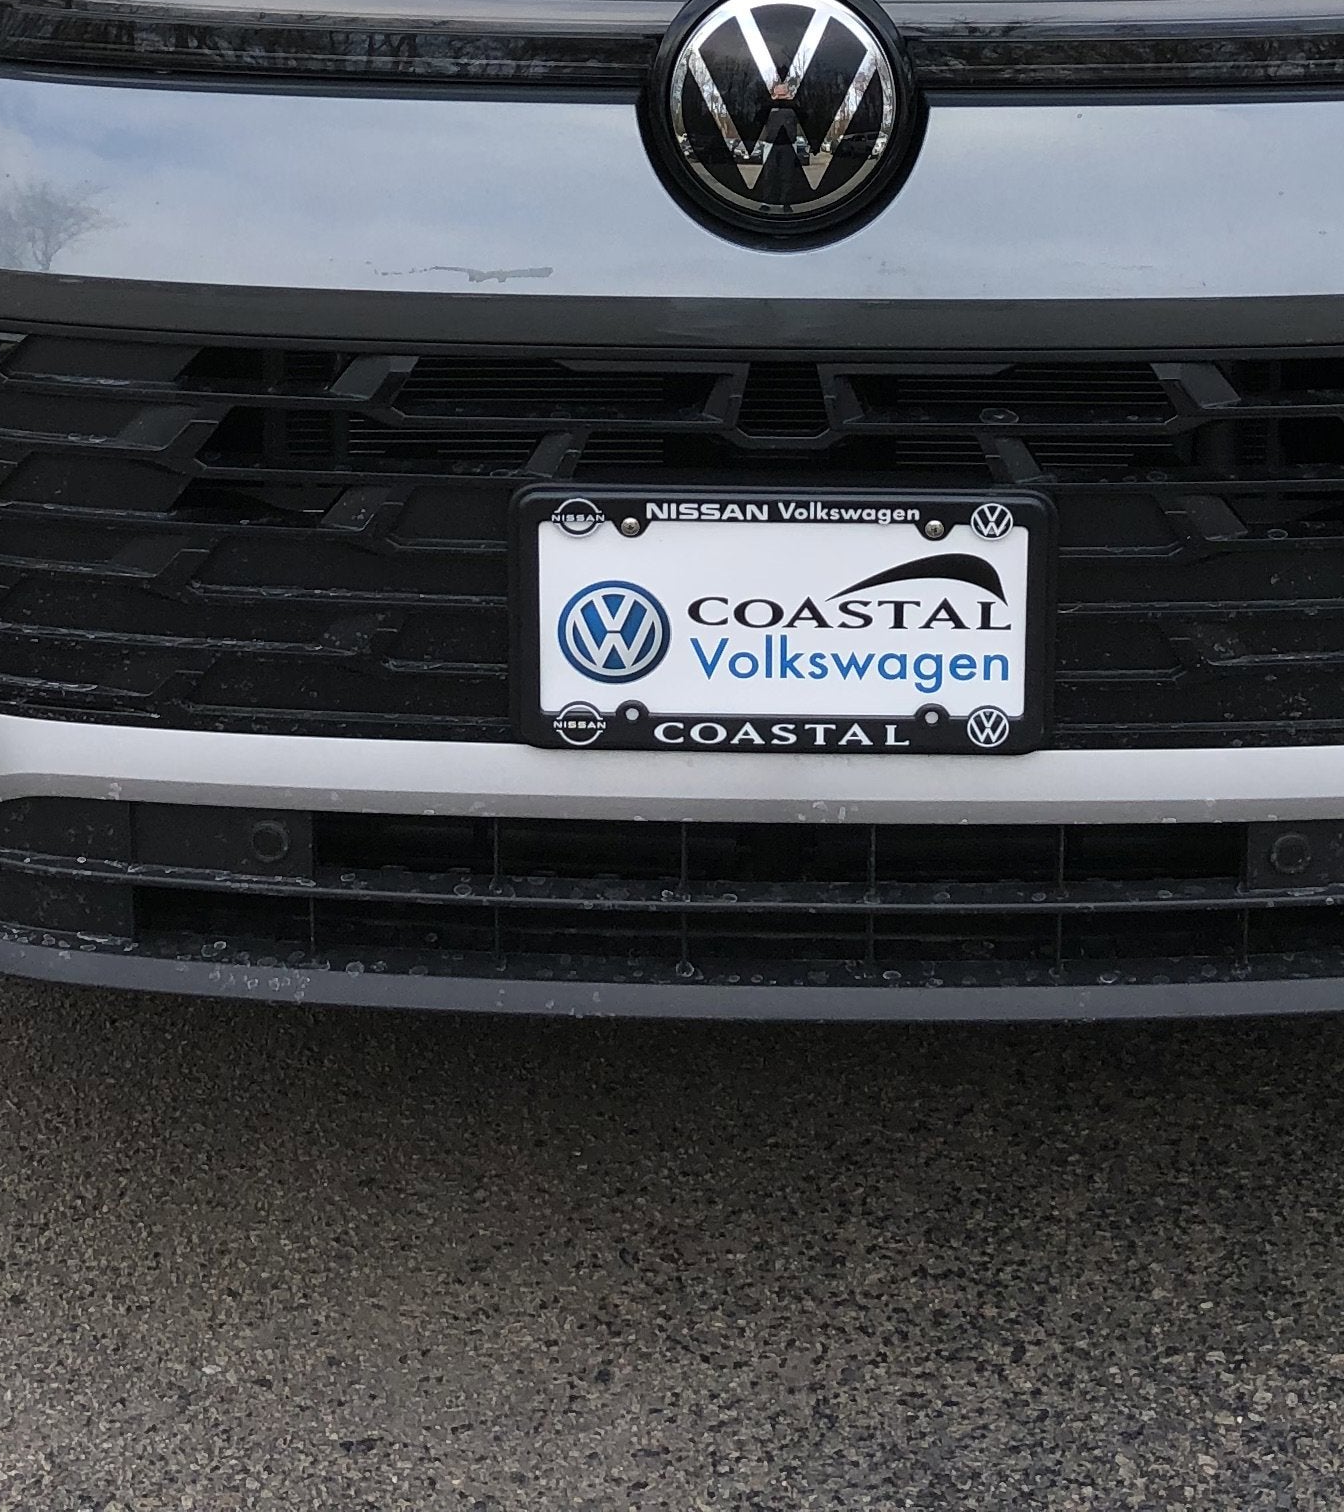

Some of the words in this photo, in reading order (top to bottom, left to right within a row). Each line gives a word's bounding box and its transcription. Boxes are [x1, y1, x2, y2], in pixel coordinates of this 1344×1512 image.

[551, 514, 605, 523] NISSAN
[645, 502, 769, 521] NISSAN
[777, 501, 921, 524] Volkswagen
[687, 595, 1013, 632] COASTAL
[689, 633, 1011, 694] Volkswagen
[553, 720, 606, 729] NISSAN
[653, 721, 911, 747] COASTAL
